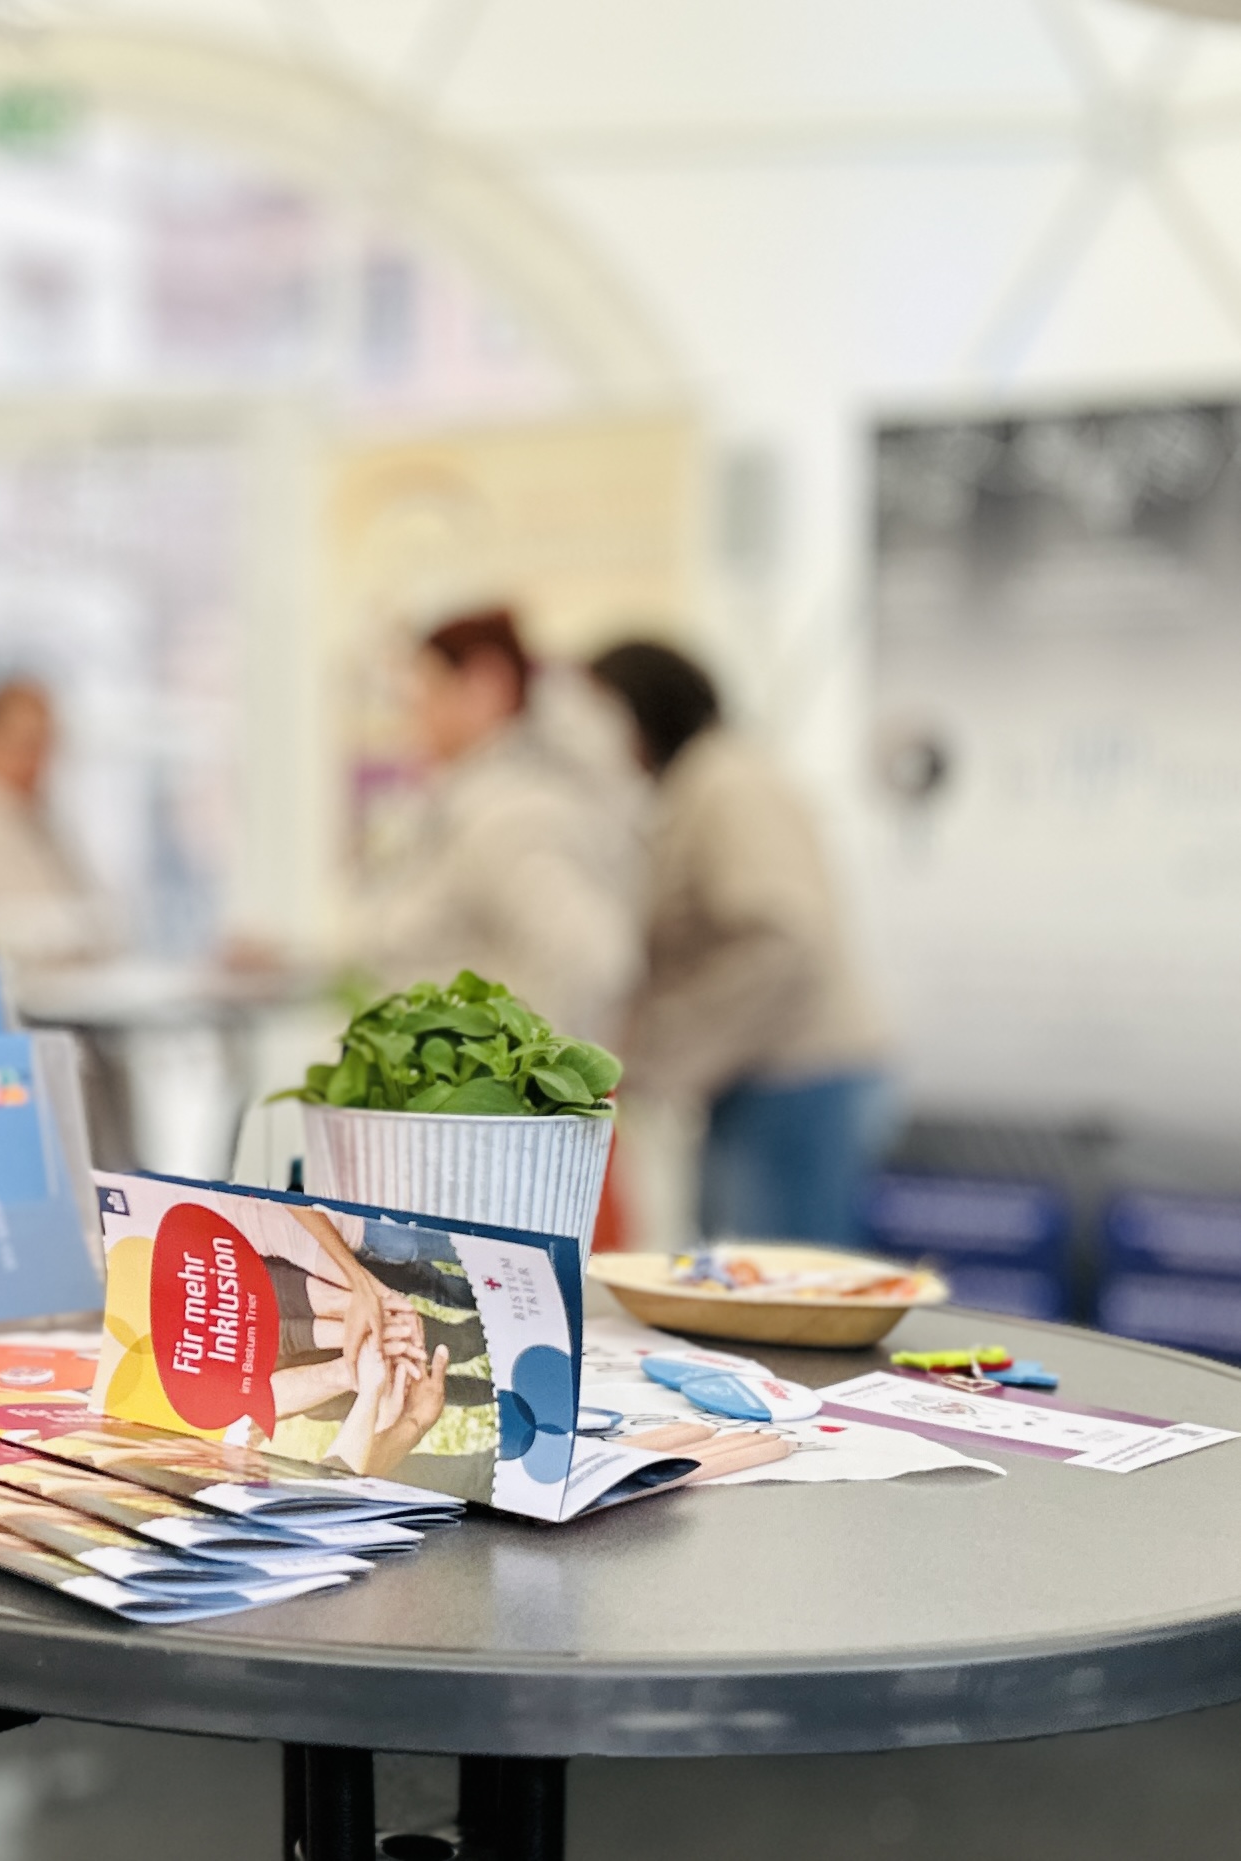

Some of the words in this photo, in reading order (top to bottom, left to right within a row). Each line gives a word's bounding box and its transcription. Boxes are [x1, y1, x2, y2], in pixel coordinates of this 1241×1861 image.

[177, 1251, 206, 1324] mehr
[207, 1237, 239, 1363] Inklusion
[244, 1292, 257, 1322] Trier
[500, 1257, 526, 1321] BISTUM
[517, 1267, 541, 1316] TRIER
[172, 1328, 204, 1375] Für
[241, 1326, 257, 1374] Bistum
[240, 1376, 252, 1394] im
